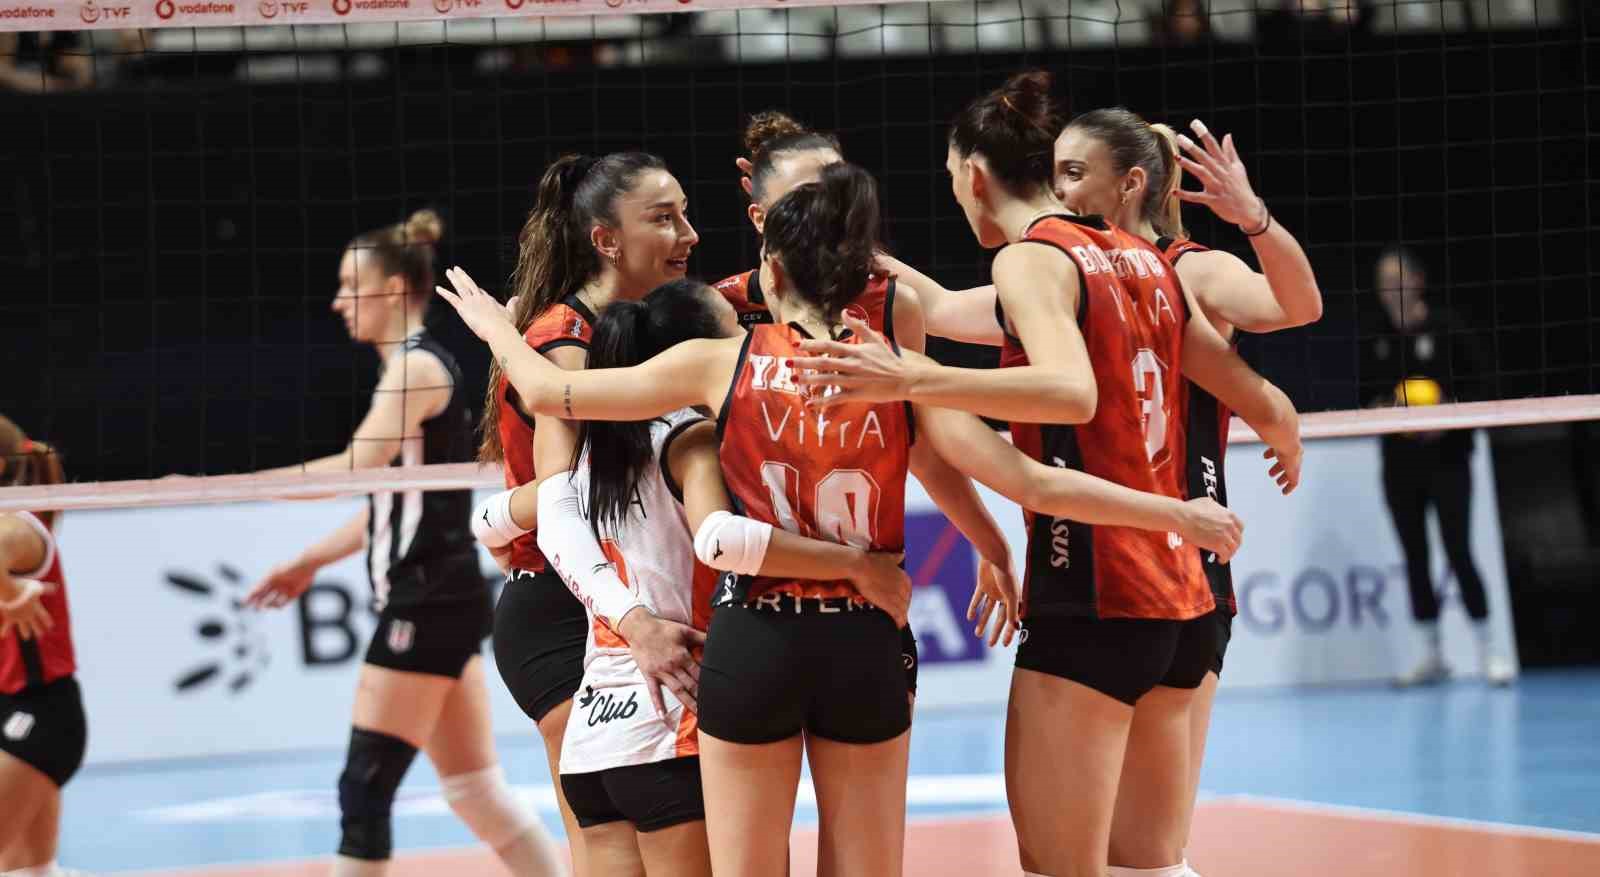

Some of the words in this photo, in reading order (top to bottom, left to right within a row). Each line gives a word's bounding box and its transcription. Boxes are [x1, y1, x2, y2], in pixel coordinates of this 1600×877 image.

[0, 7, 56, 18] vodafone
[102, 7, 131, 19] TVF
[178, 2, 235, 14] vodafone
[281, 2, 310, 14] TVF
[587, 690, 639, 728] Club
